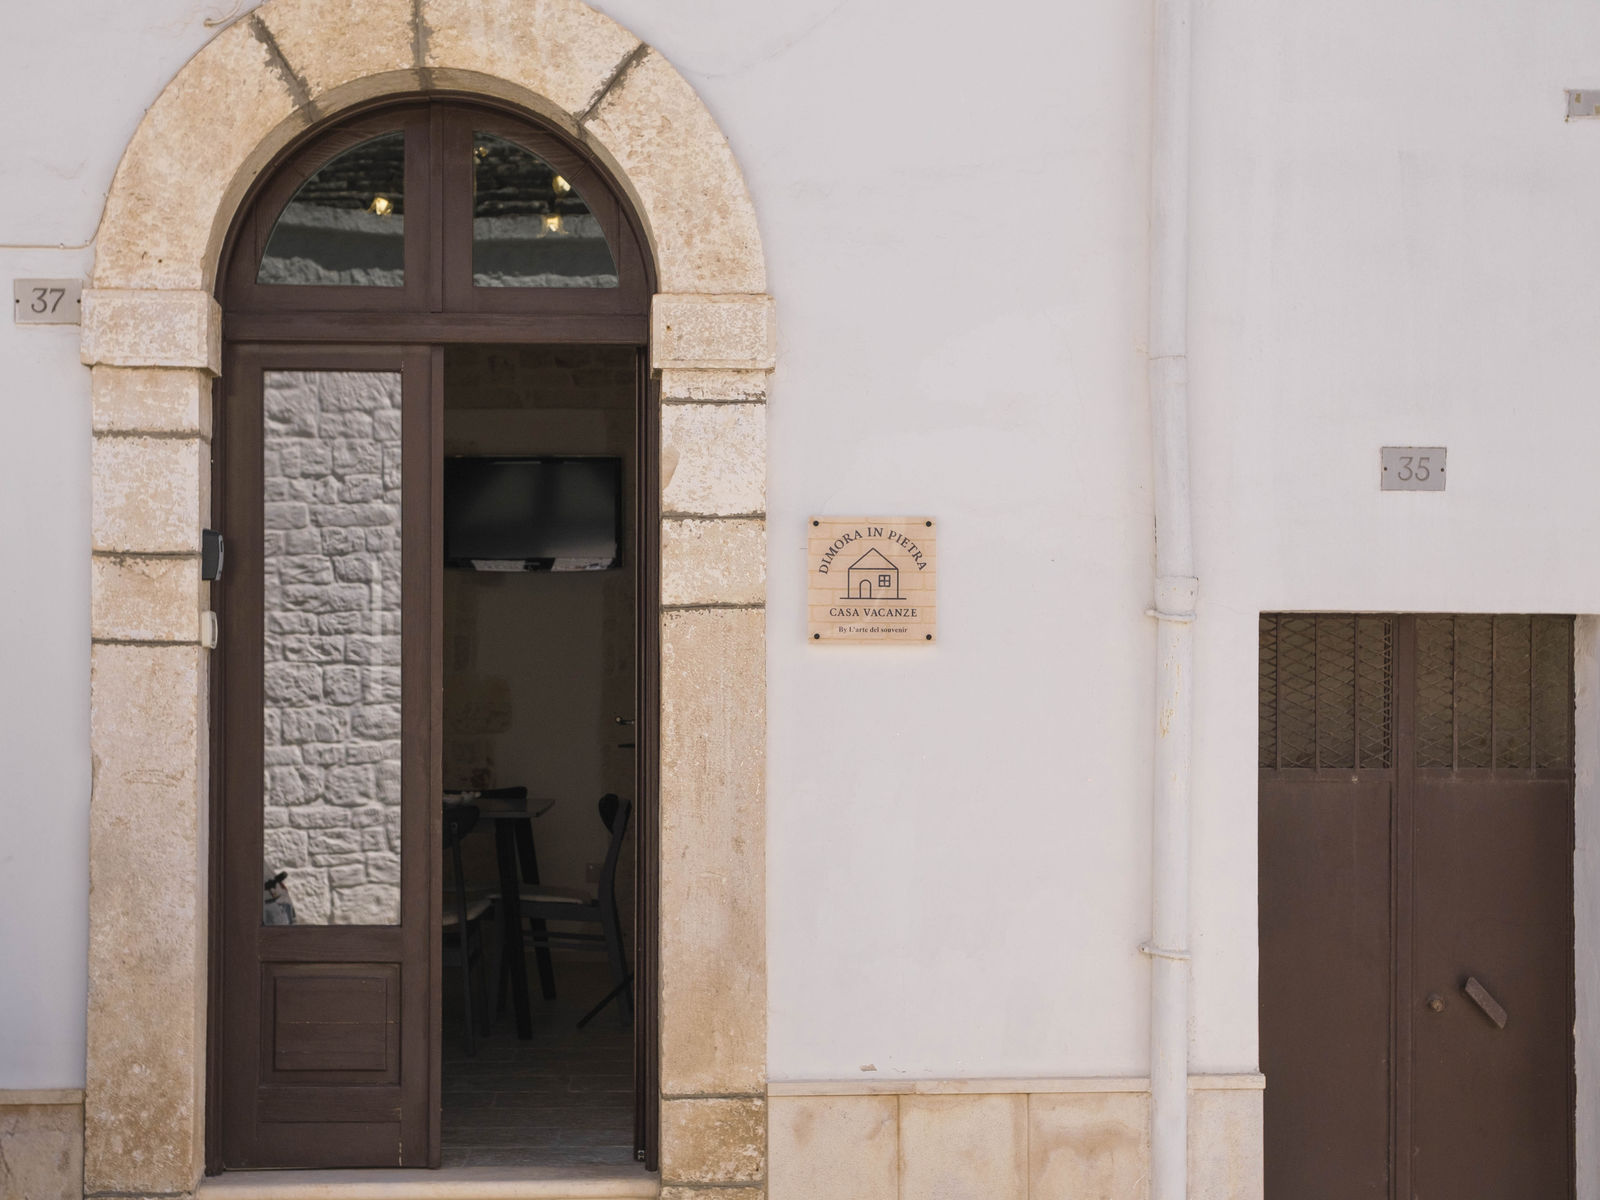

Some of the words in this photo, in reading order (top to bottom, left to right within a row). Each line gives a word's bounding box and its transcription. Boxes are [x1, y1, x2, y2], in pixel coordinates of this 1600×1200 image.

[31, 287, 66, 314] 37
[1398, 456, 1430, 481] 35
[819, 529, 863, 575] DIMORA
[867, 527, 884, 537] IN
[887, 530, 927, 571] PIETRA
[829, 607, 860, 617] CASA
[863, 608, 918, 617] VACANZE
